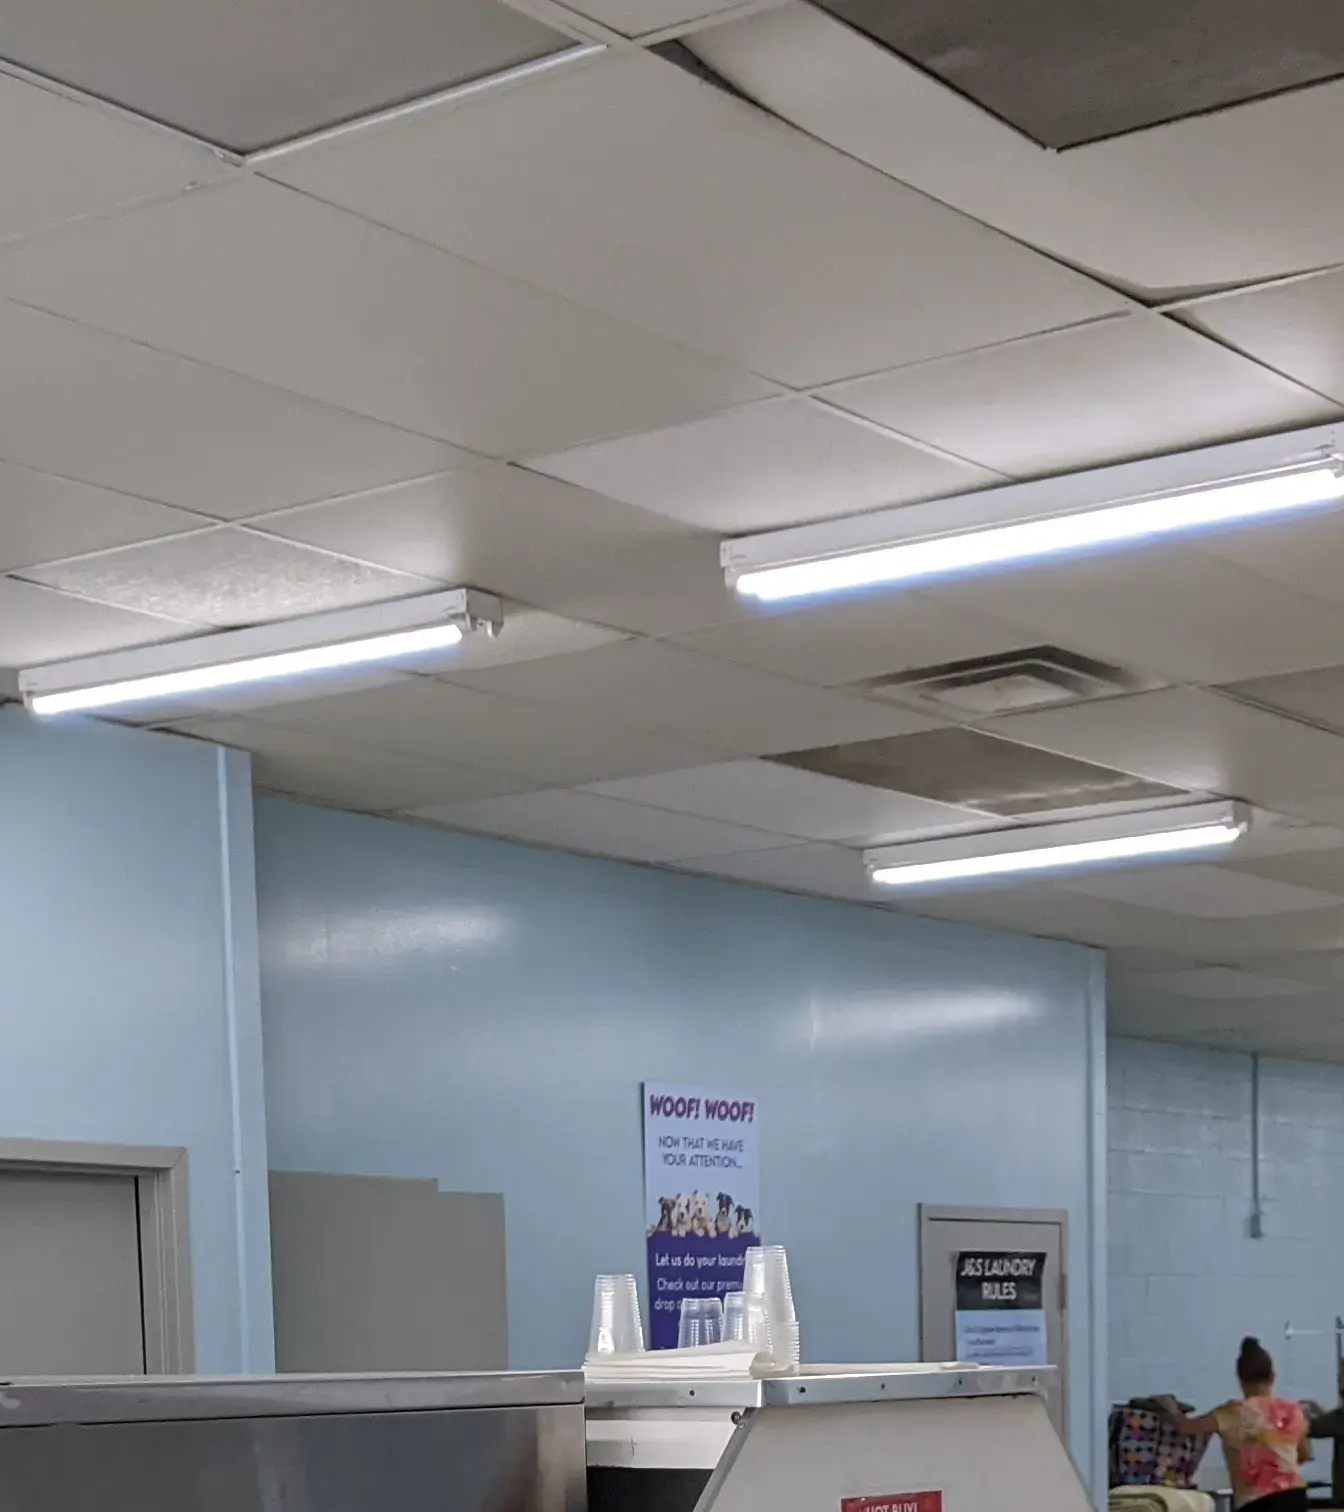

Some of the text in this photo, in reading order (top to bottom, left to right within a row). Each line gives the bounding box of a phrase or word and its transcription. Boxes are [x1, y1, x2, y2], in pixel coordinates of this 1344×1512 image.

[650, 1094, 755, 1123] WOOF! WOOF!
[658, 1136, 680, 1149] NOW
[683, 1137, 704, 1149] THAT
[721, 1139, 744, 1152] HAVE
[662, 1153, 686, 1166] YOUR
[655, 1253, 747, 1269] Let us do your laundr
[657, 1277, 684, 1291] Check
[685, 1279, 700, 1291] out
[701, 1281, 716, 1291] our
[981, 1281, 1017, 1300] RULES
[654, 1297, 676, 1314] drop
